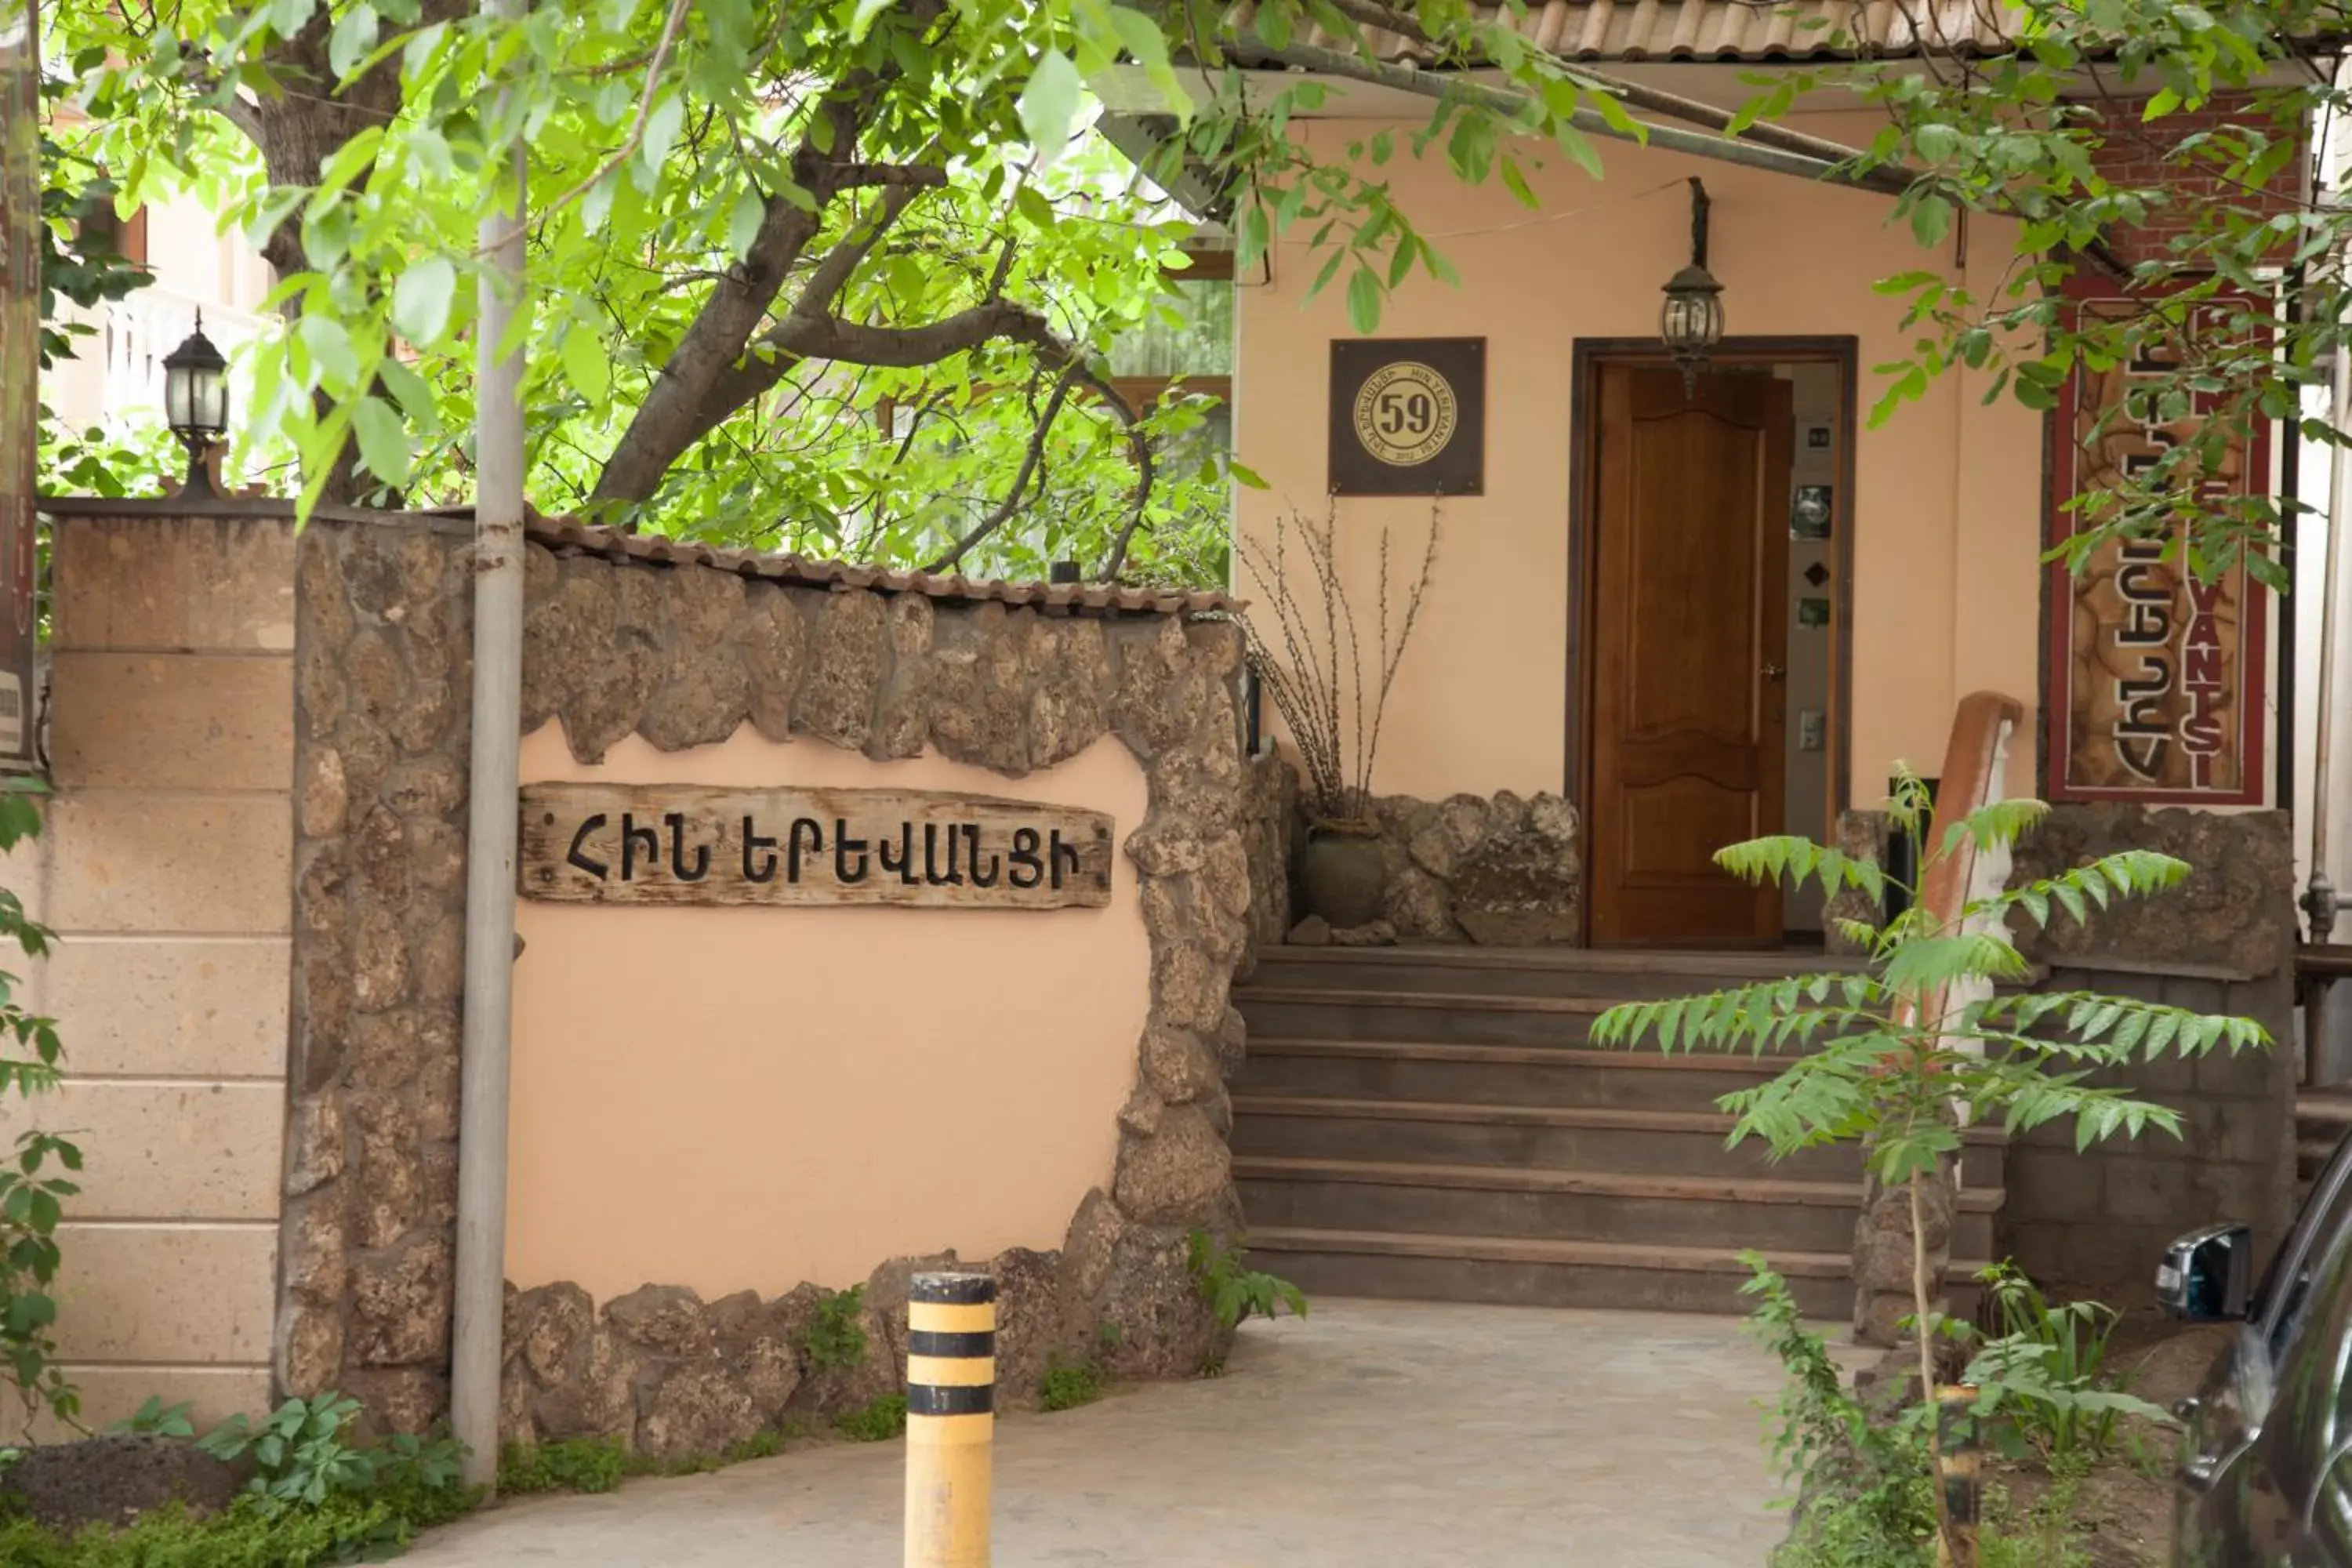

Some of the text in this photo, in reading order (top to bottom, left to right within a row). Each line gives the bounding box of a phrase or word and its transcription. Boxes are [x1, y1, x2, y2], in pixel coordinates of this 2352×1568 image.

[1381, 394, 1431, 434] 59
[2114, 655, 2172, 782] ՀԻՆ
[566, 812, 1080, 889] ՀԻՆ ԵՐԵՎԱՆՑԻ
